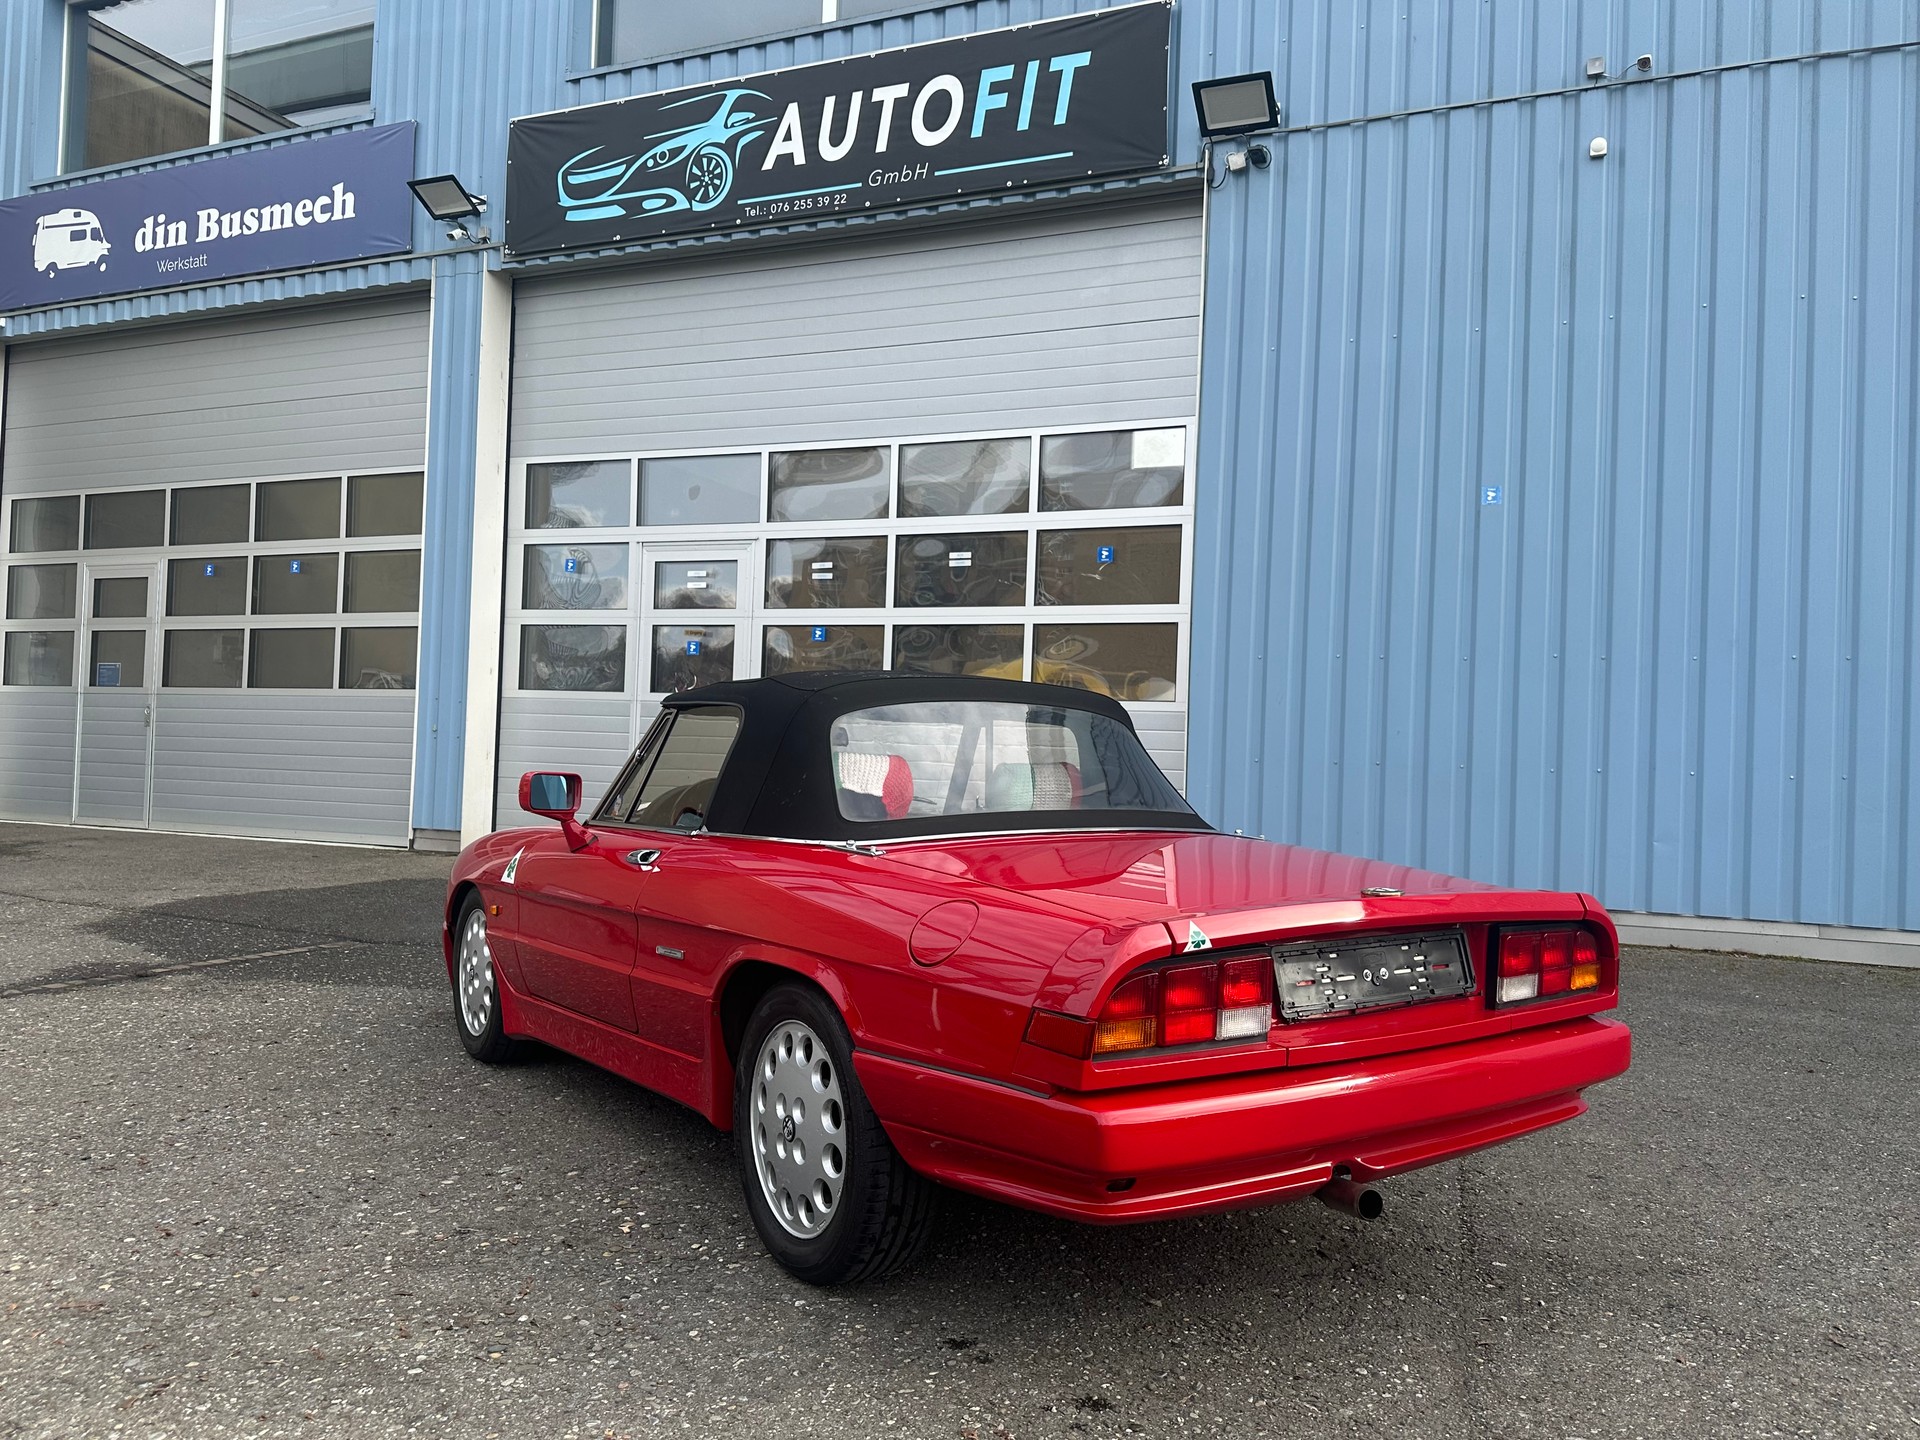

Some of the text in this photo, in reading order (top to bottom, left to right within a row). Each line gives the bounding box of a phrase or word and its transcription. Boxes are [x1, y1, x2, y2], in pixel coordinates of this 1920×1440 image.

[761, 51, 1092, 171] AUTOFIT
[868, 163, 929, 187] GmbH
[744, 193, 847, 217] Tel.: 076 255 39 22
[134, 182, 356, 253] din Busmech
[156, 253, 208, 273] Werkstatt
